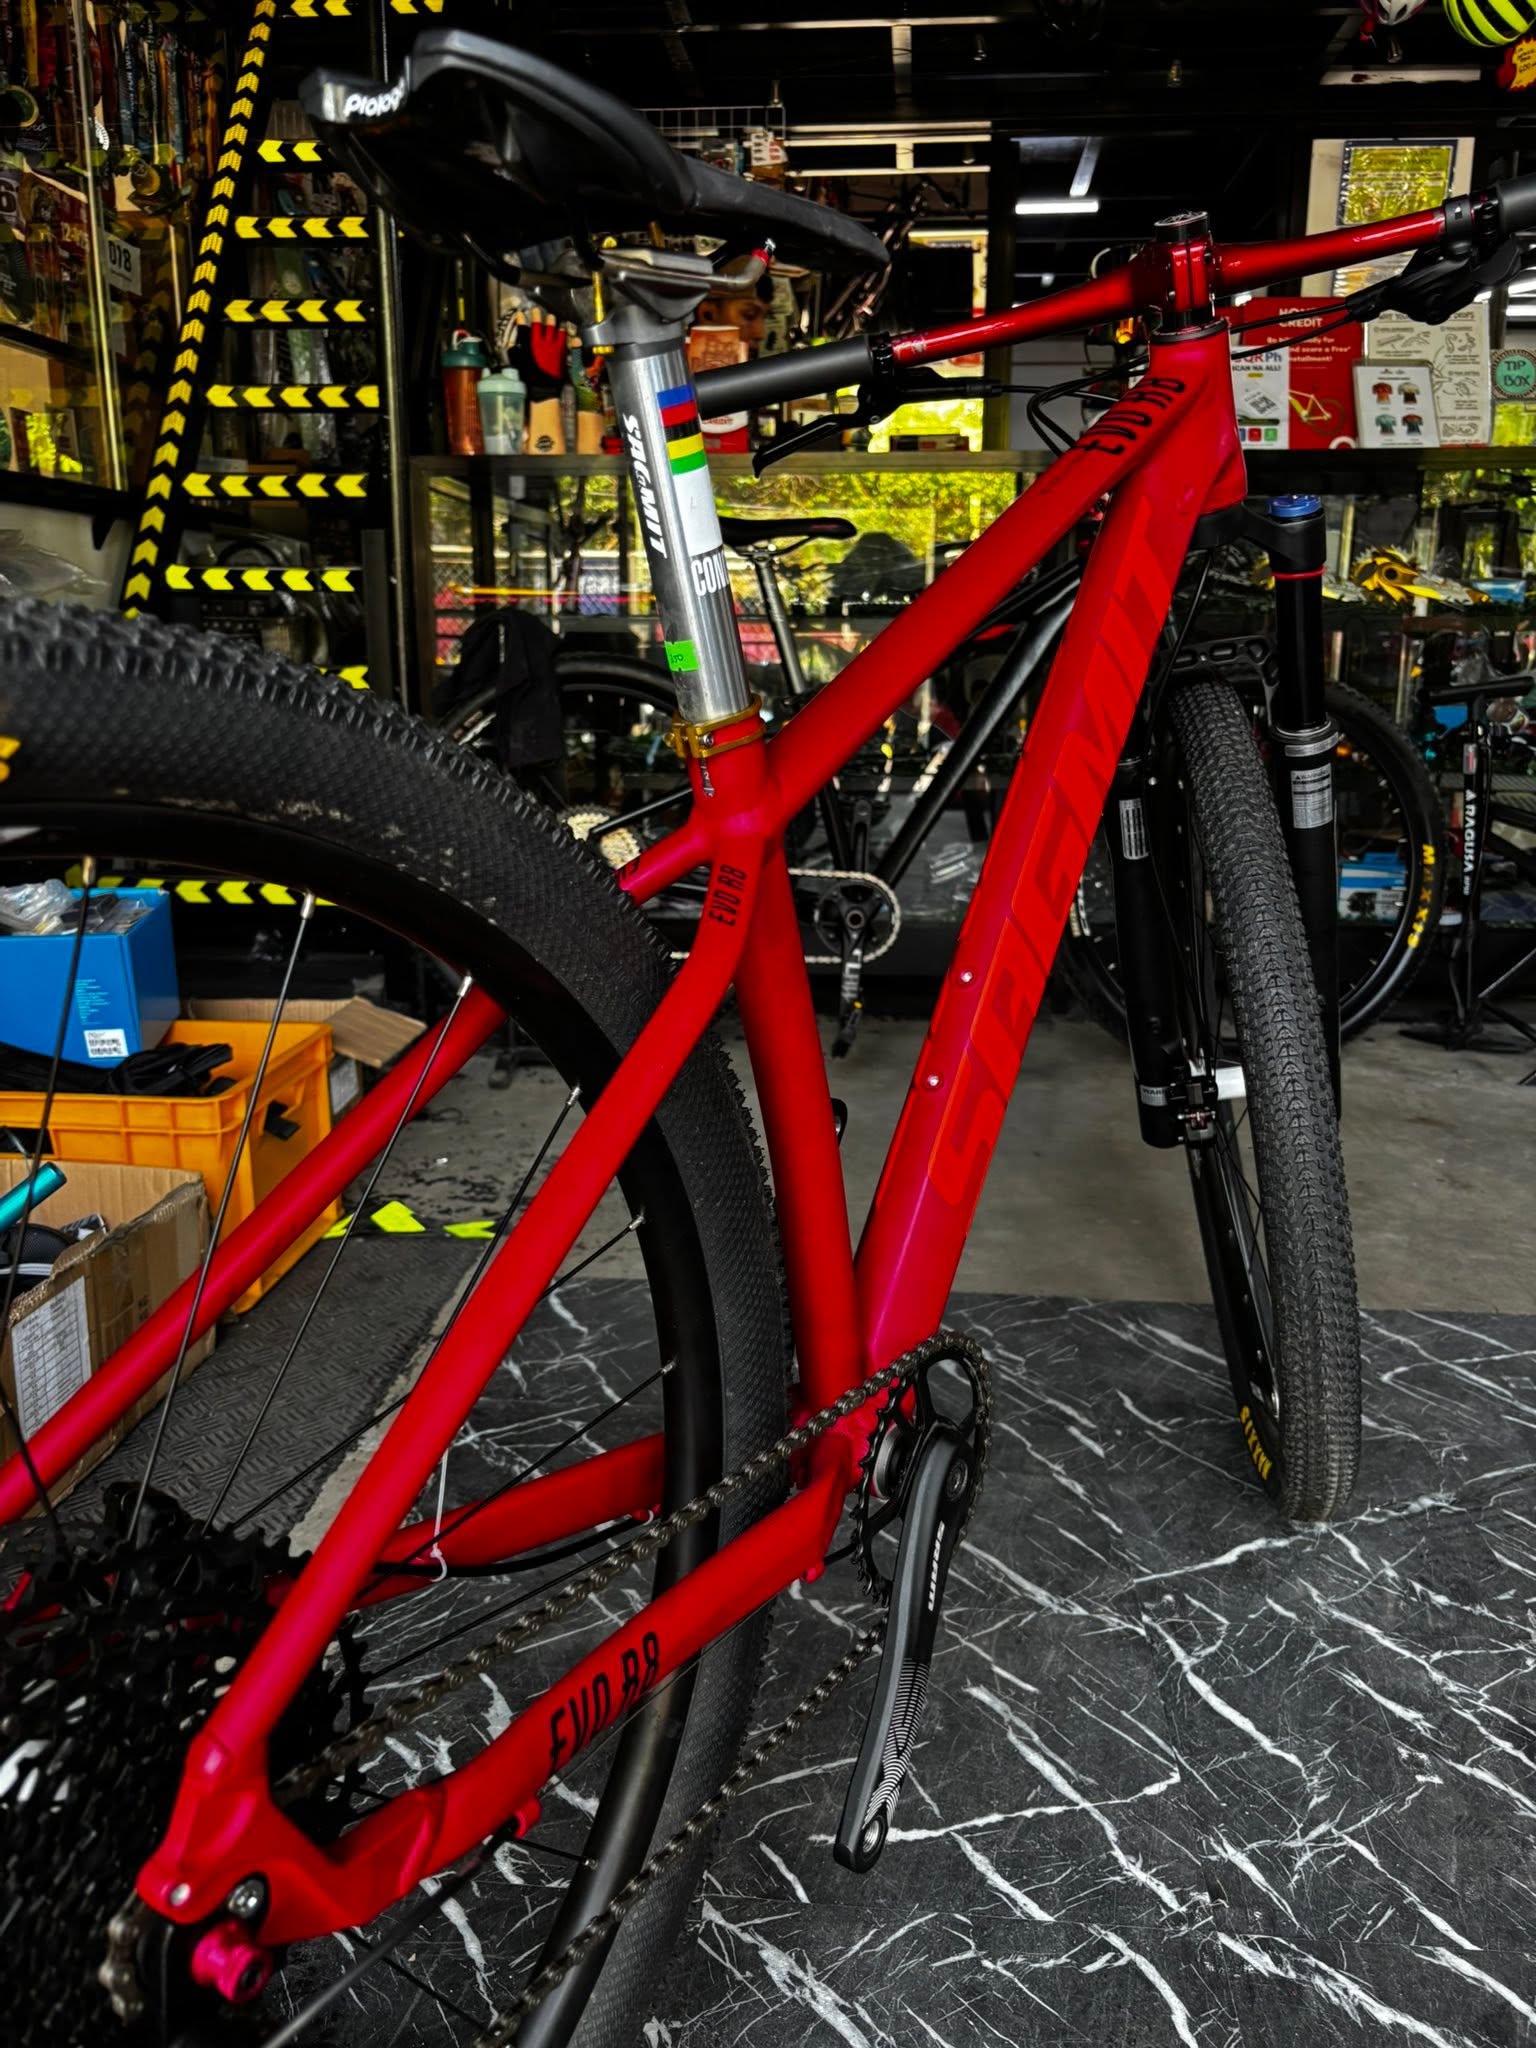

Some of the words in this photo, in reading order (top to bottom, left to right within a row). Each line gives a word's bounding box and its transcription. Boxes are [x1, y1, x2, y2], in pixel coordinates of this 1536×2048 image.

[1279, 317, 1323, 328] CREDIT
[1503, 375, 1531, 388] BOX
[1504, 360, 1527, 371] TIP
[622, 413, 669, 559] SAGMIT
[928, 495, 1172, 1207] SAGMIT
[1463, 804, 1477, 873] RAGUSA
[708, 889, 741, 927] EVO
[927, 1520, 946, 1612] SRAM
[550, 1672, 611, 1773] EVO
[620, 1631, 660, 1713] R8
